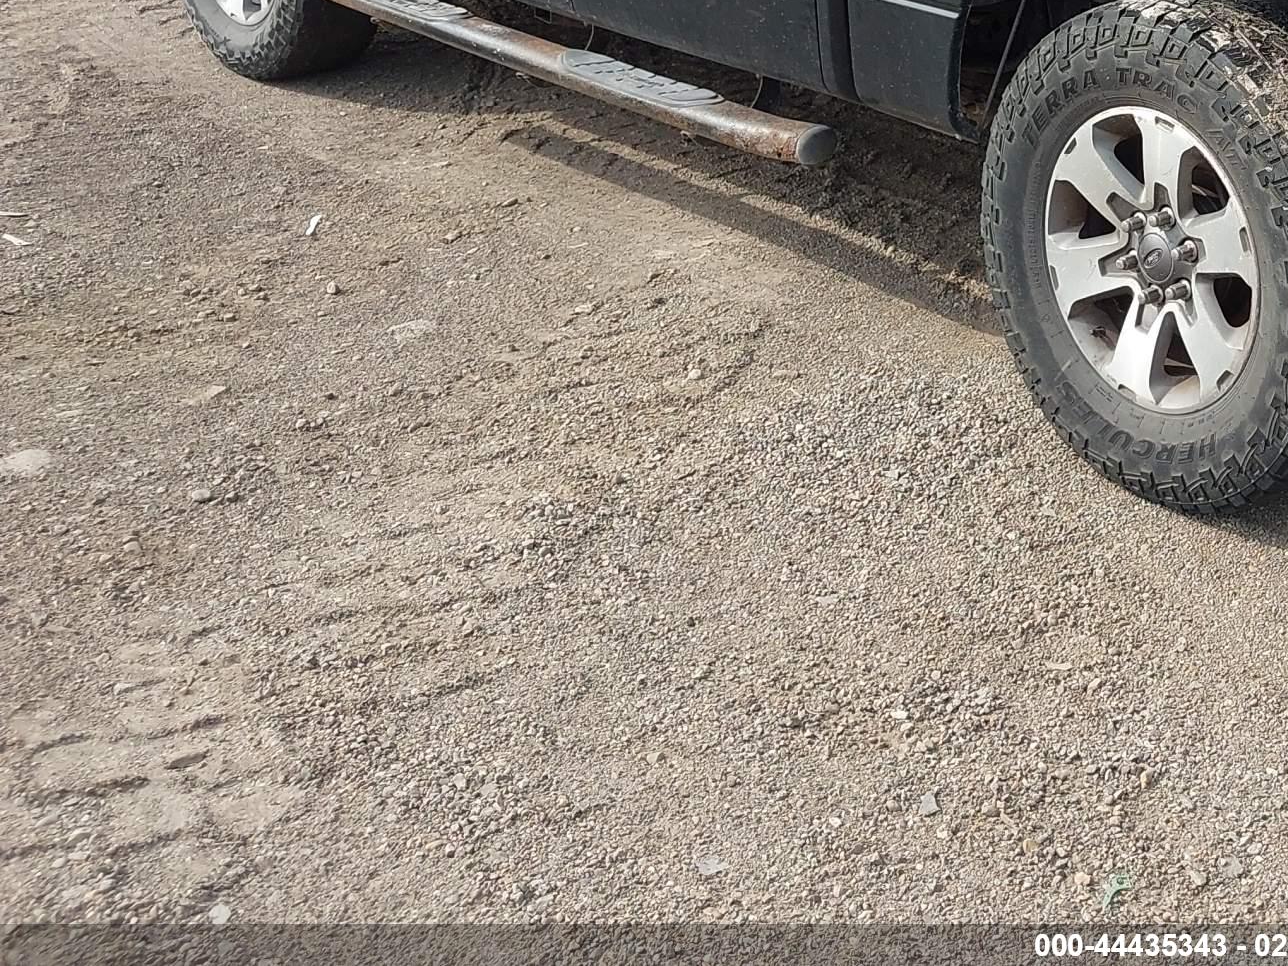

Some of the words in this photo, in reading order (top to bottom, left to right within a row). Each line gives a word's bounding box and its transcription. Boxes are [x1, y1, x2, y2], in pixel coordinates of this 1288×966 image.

[1021, 69, 1098, 148] TERRA
[1115, 66, 1200, 114] TRAC
[1056, 380, 1217, 465] HERCULES
